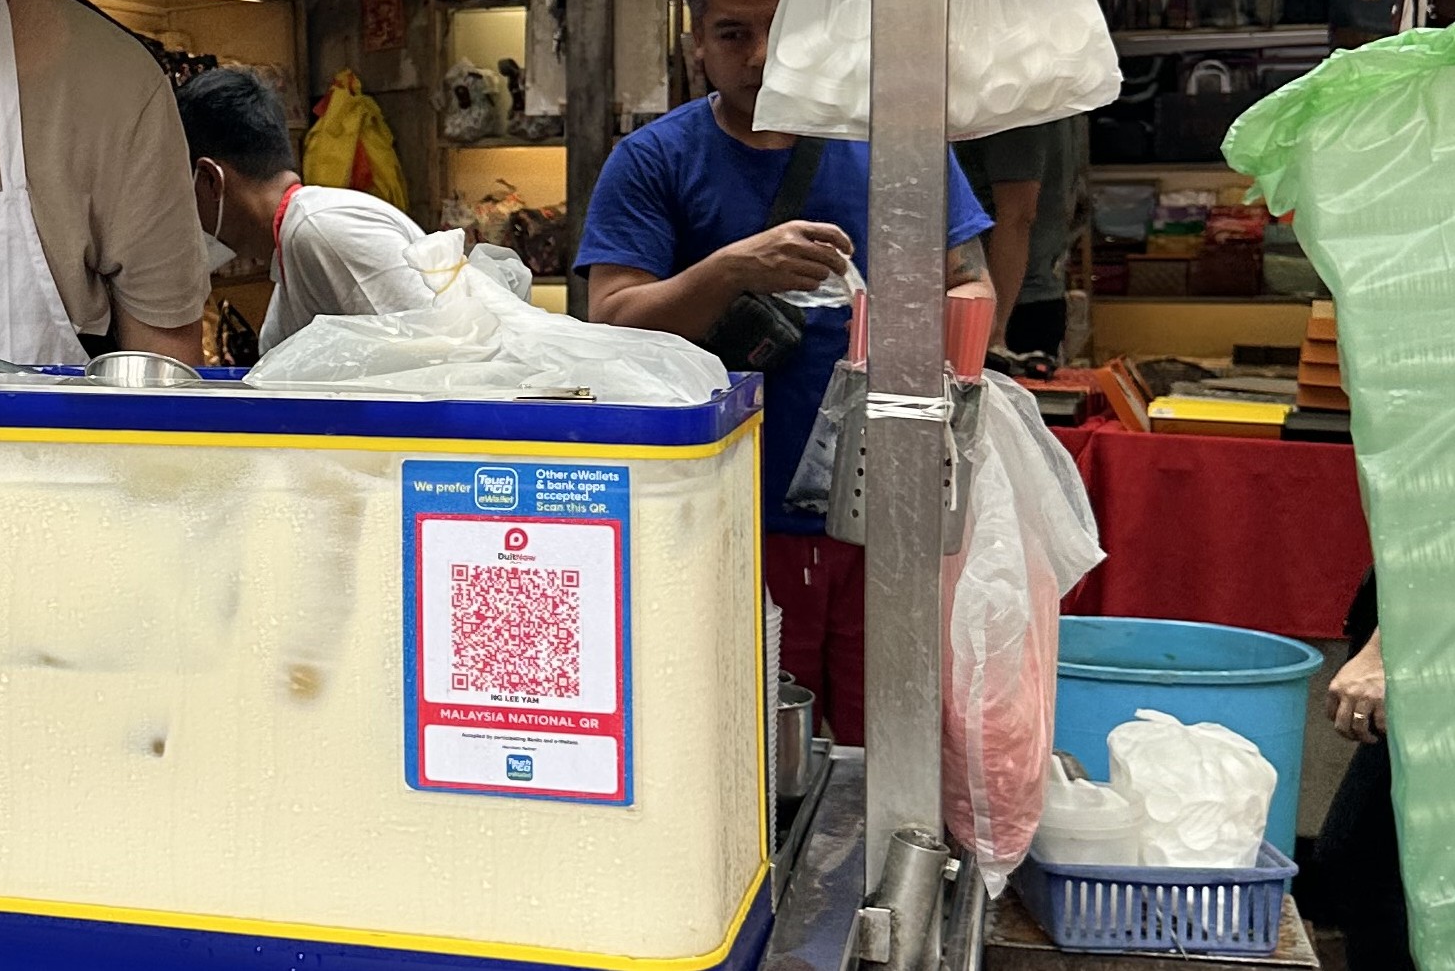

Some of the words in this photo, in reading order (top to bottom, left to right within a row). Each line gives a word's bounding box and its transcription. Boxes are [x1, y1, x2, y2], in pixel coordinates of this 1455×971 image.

[478, 475, 514, 486] Touch
[536, 469, 568, 480] Other
[570, 471, 619, 481] eWallets
[414, 481, 433, 491] We
[436, 482, 471, 493] prefer
[547, 482, 575, 490] bank
[578, 482, 606, 492] apps
[536, 491, 592, 501] accepted.
[536, 502, 564, 512] Scan
[567, 503, 587, 512] this
[589, 504, 609, 513] QR.
[498, 553, 536, 562] DuitNow
[491, 694, 502, 702] NG
[505, 695, 519, 703] LEE
[521, 696, 539, 704] YAM
[440, 709, 505, 723] MALAYSIA
[508, 715, 575, 727] NATIONAL
[579, 718, 599, 729] QR
